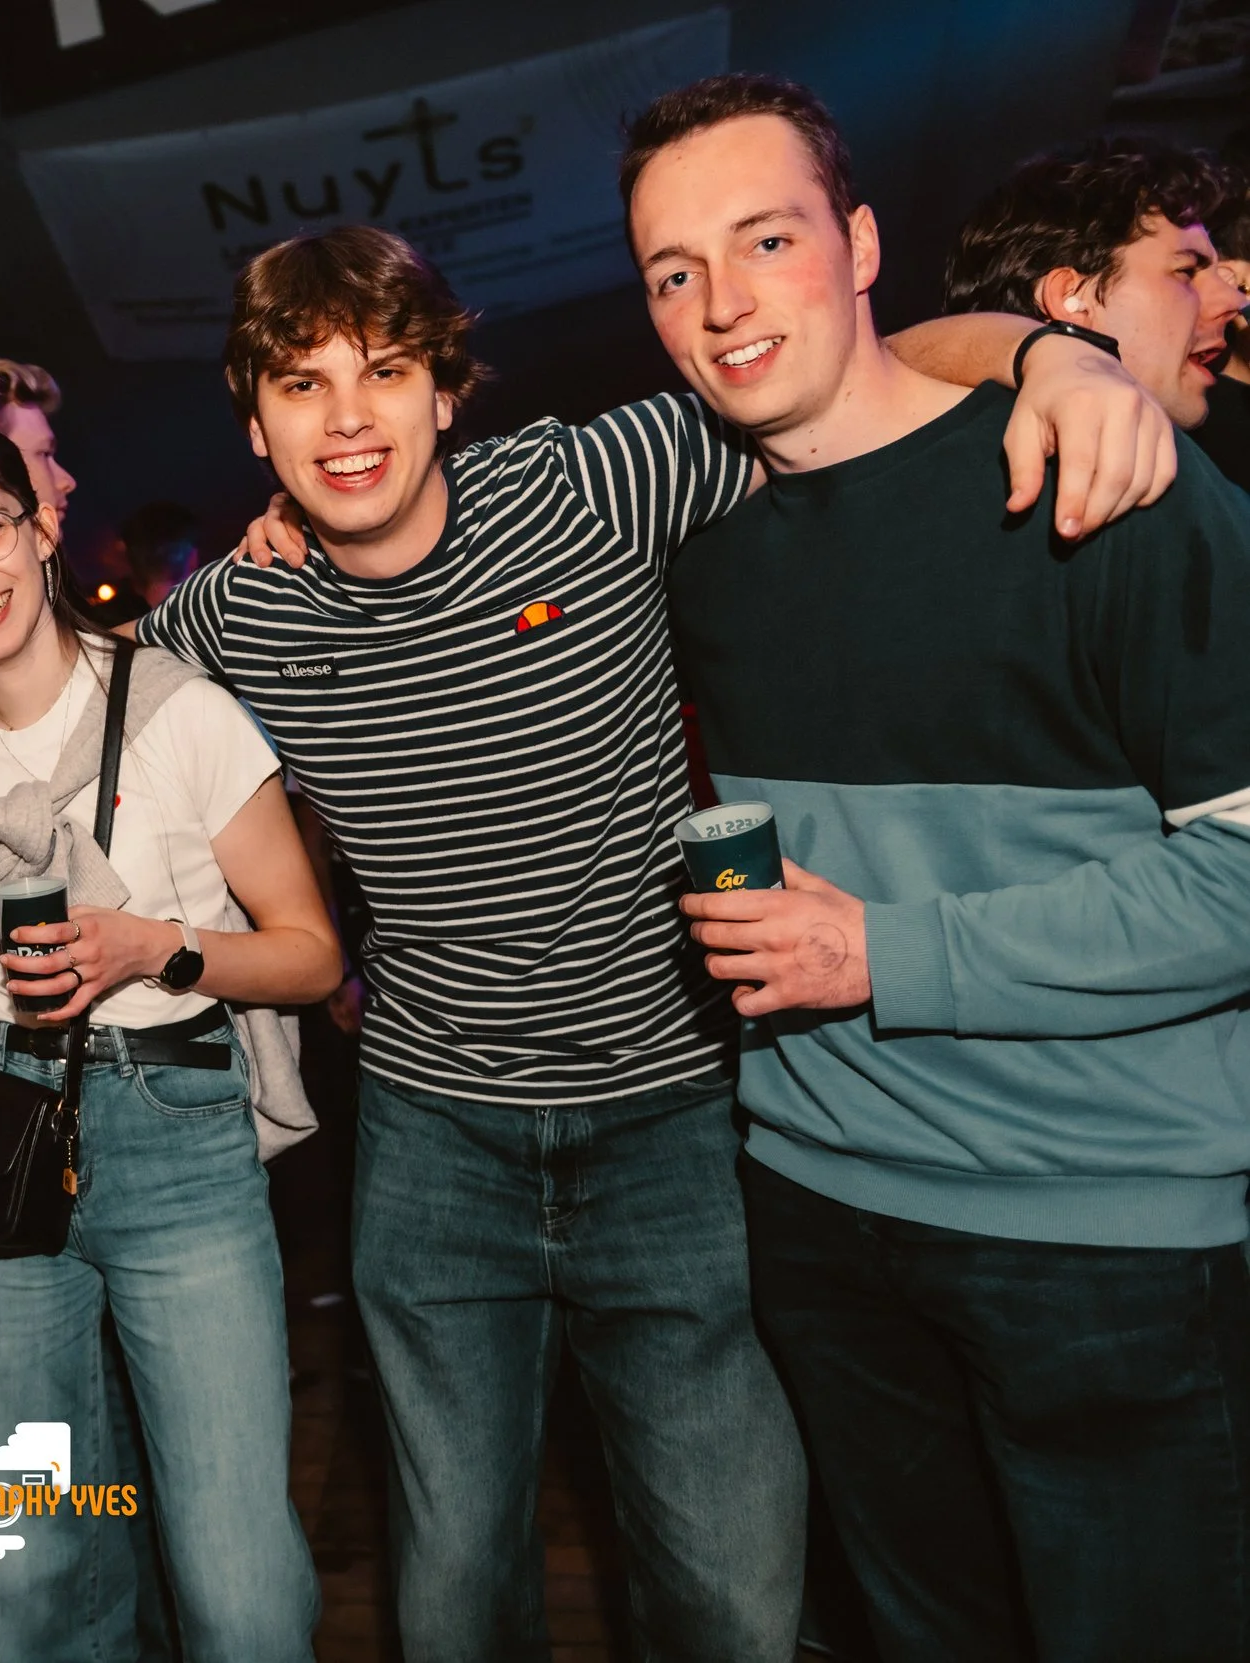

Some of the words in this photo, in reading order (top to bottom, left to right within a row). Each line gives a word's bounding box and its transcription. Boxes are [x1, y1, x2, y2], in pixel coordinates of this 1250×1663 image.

[203, 97, 525, 231] Nuyts
[282, 664, 332, 677] ellesse
[716, 868, 749, 889] Go
